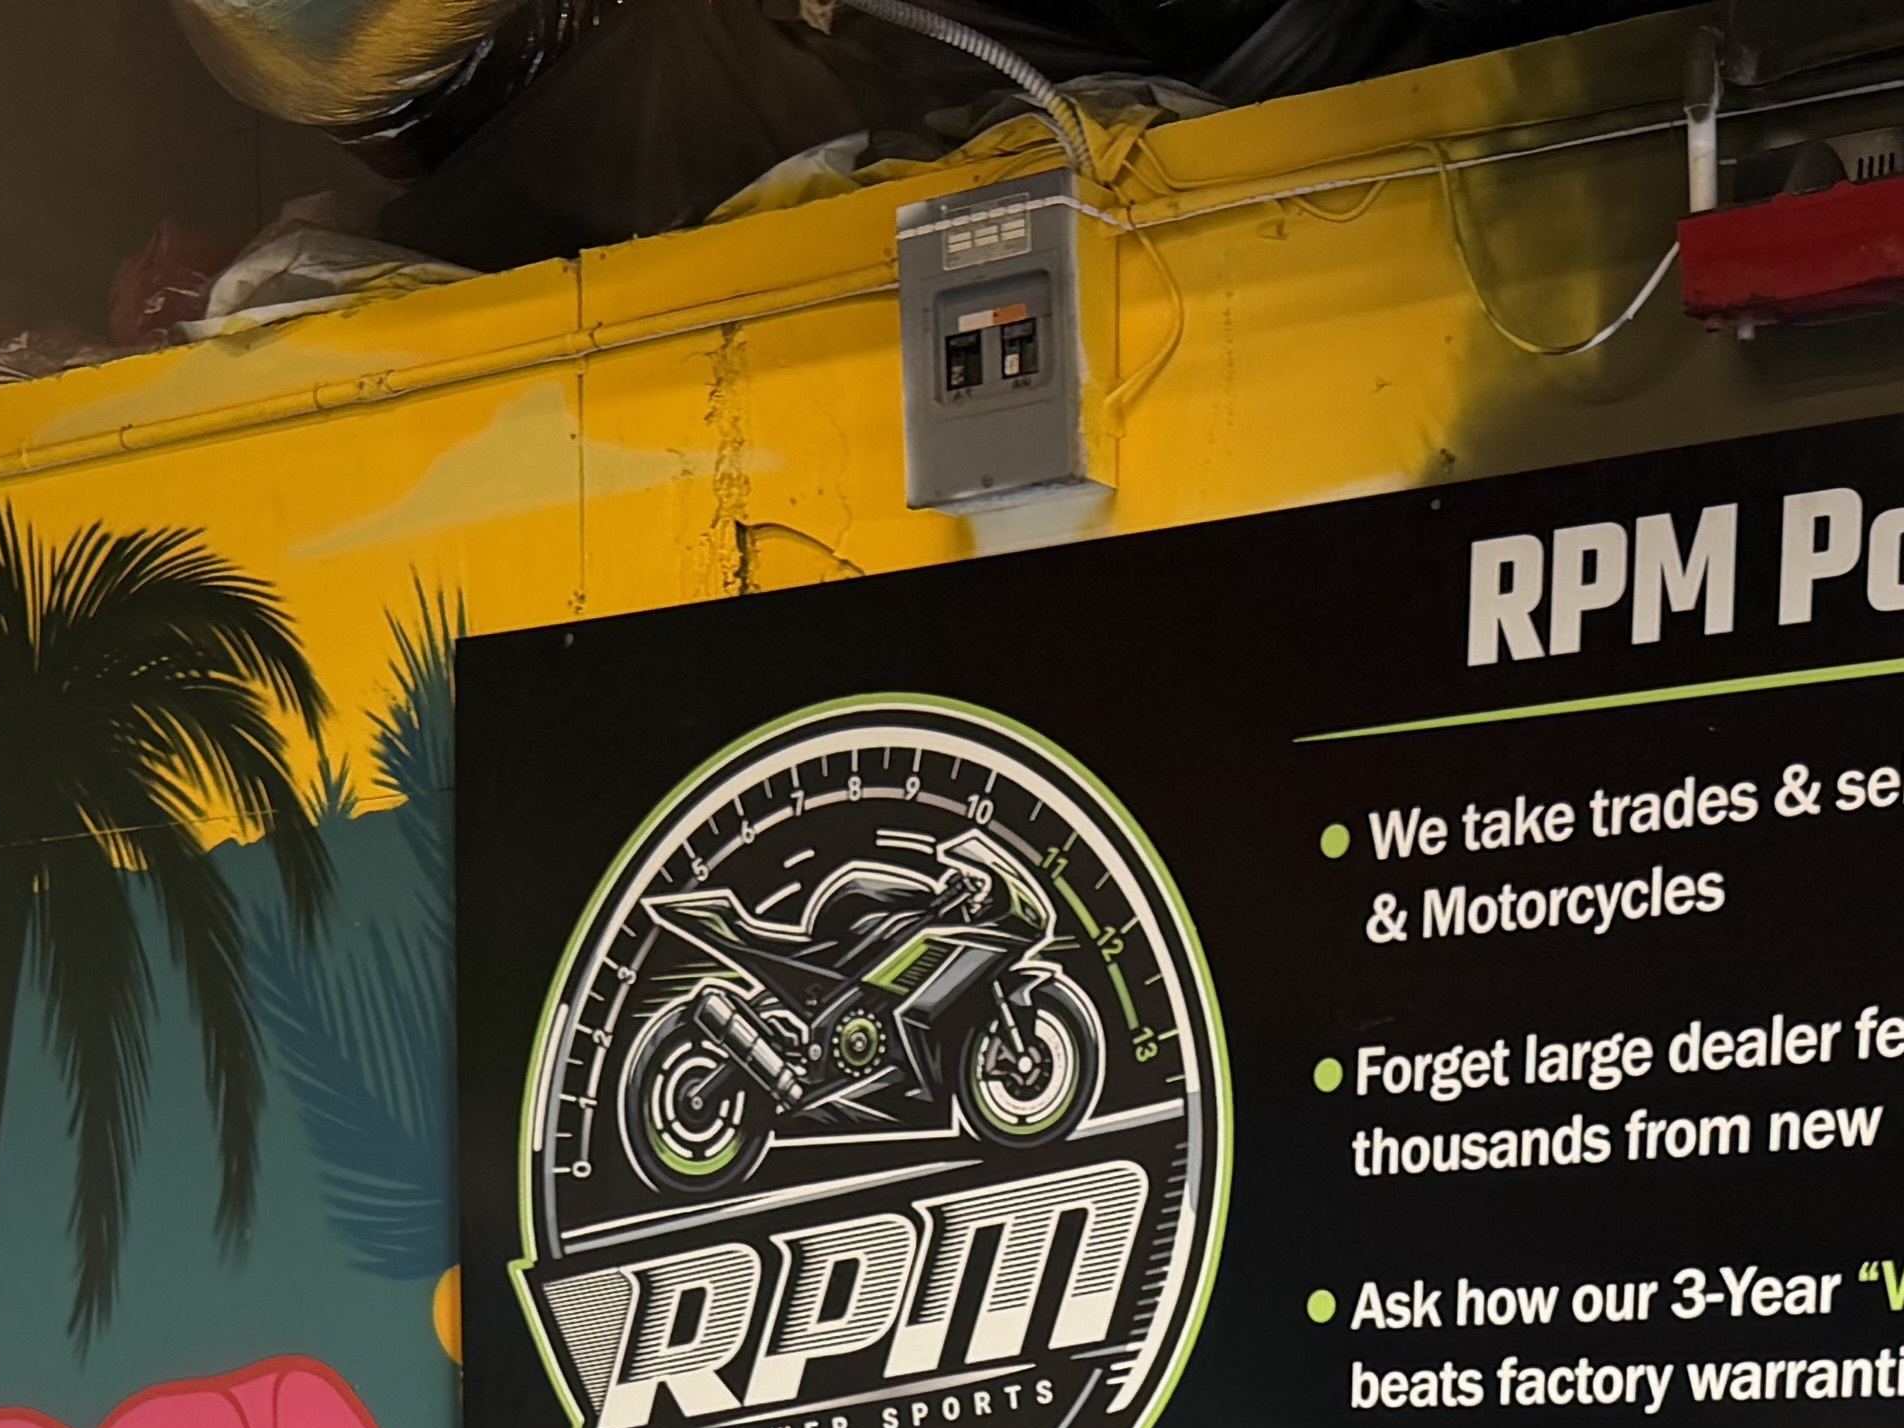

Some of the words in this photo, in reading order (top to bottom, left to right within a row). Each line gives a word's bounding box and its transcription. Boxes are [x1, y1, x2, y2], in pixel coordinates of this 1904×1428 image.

[1467, 502, 1738, 667] RPM
[847, 775, 863, 801] 8
[904, 775, 922, 801] 9
[966, 793, 995, 825] 10
[1368, 807, 1448, 860] We
[1461, 795, 1575, 851] take
[1589, 776, 1759, 838] trades
[1774, 763, 1822, 817] &
[1366, 893, 1408, 944] &
[1422, 865, 1725, 939] Motorcycles
[1356, 1039, 1510, 1102] Forget
[1525, 1032, 1654, 1091] large
[1668, 1014, 1842, 1073] dealer
[1351, 1113, 1612, 1177] thousands
[1624, 1108, 1751, 1161] from
[1769, 1106, 1884, 1152] new
[1350, 1279, 1442, 1330] Ask
[1456, 1278, 1560, 1326] how
[1572, 1281, 1659, 1323] our
[1670, 1265, 1842, 1319] 3-Year
[1351, 1361, 1484, 1409] beats
[1496, 1356, 1674, 1415] factory
